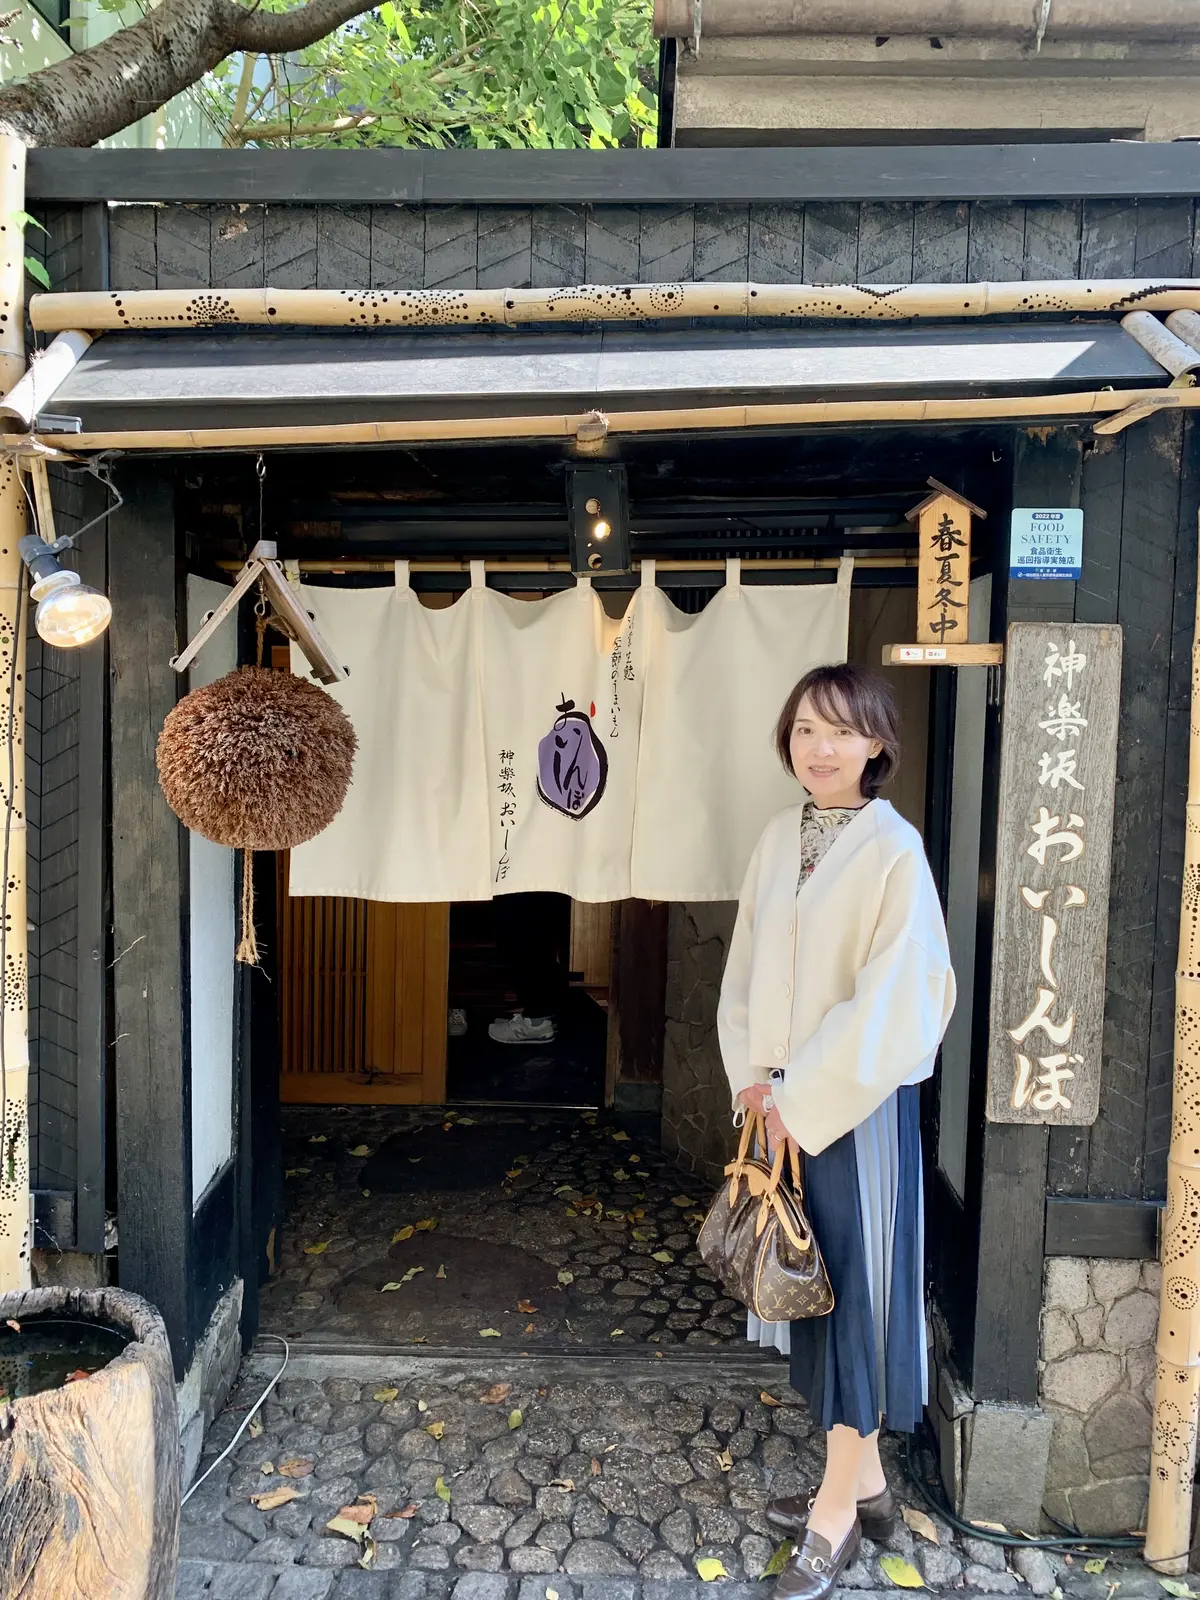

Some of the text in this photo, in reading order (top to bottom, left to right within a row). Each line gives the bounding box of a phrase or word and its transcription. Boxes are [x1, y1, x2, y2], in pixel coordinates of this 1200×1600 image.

[1030, 522, 1065, 532] FOOD
[1020, 534, 1072, 544] SAFETY
[1030, 546, 1063, 556] 食品衛生
[1017, 555, 1075, 565] 巡回指導実施店
[928, 512, 968, 643] 春夏冬中
[1038, 640, 1088, 791] 神楽坂
[1006, 805, 1088, 1112] おいしんぼ
